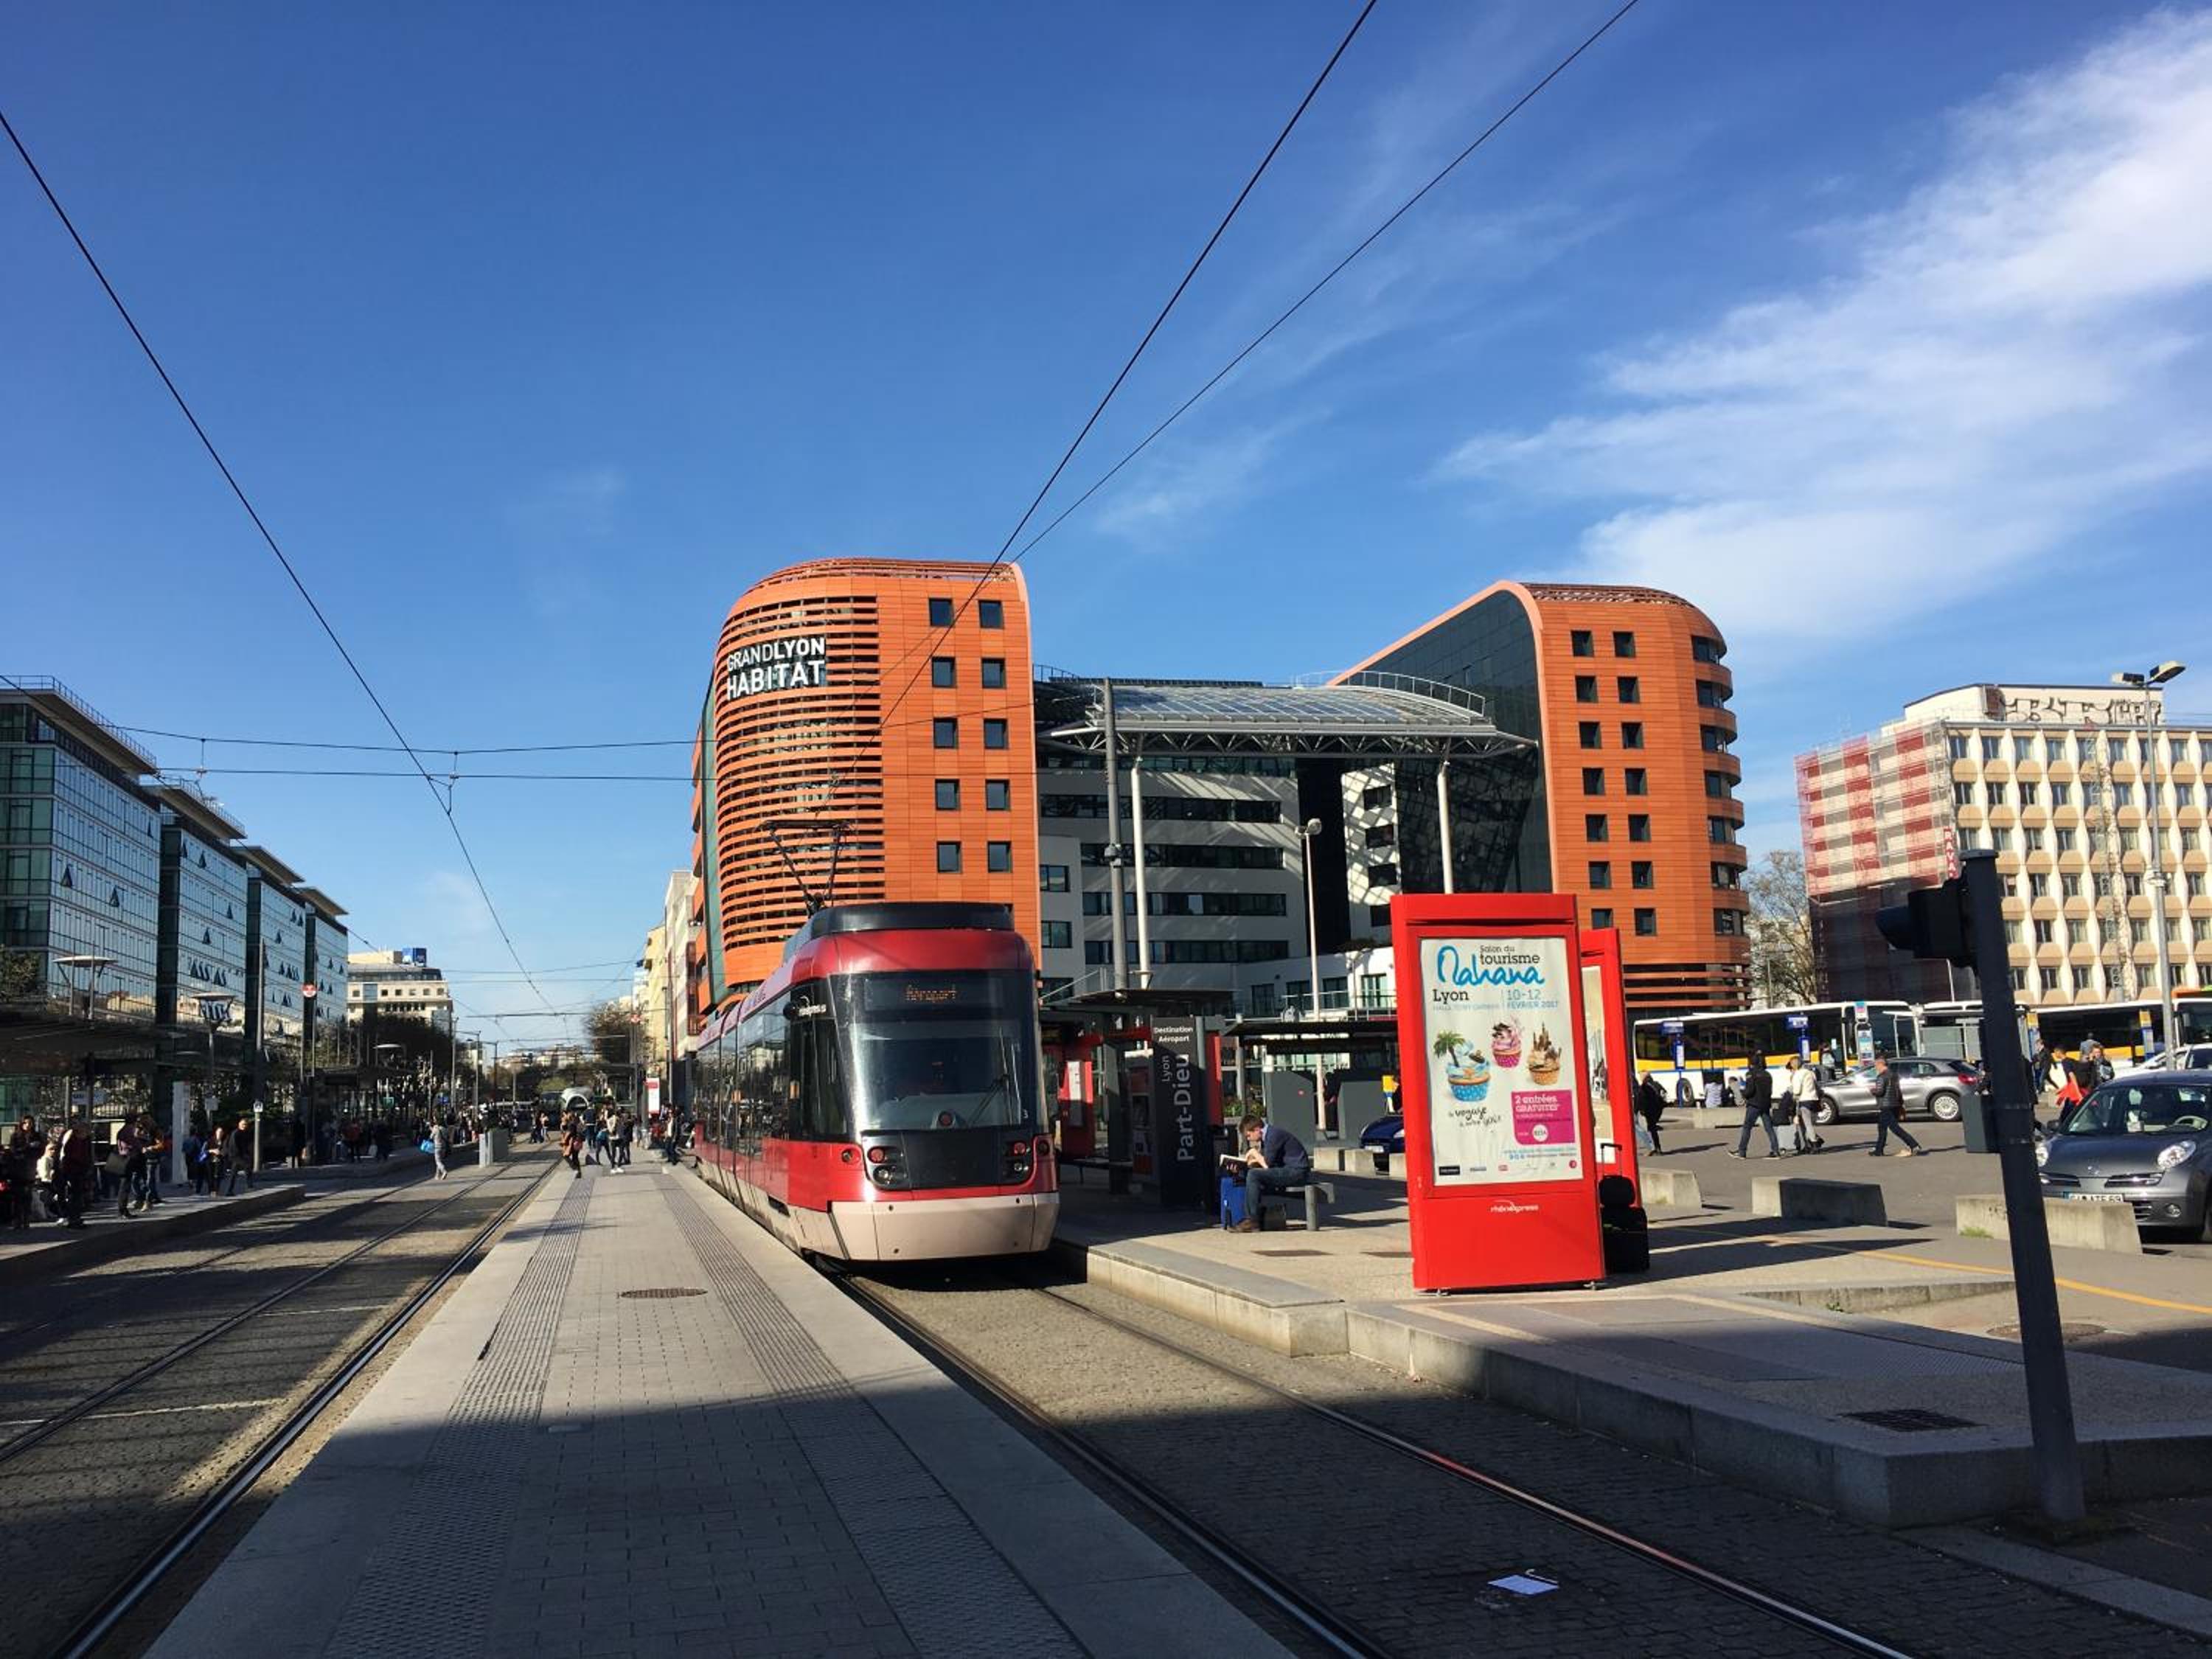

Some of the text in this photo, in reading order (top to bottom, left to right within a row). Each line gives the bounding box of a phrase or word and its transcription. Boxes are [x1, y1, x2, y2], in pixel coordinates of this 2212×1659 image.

[726, 660, 825, 700] HABITAT
[1480, 953, 1540, 965] tourisme
[1433, 989, 1469, 1004] Lyon
[1158, 1035, 1189, 1044] Aéroport
[1162, 1055, 1172, 1082] Lyon
[1515, 1095, 1521, 1104] 2
[1172, 1054, 1194, 1161] Part-Dieu
